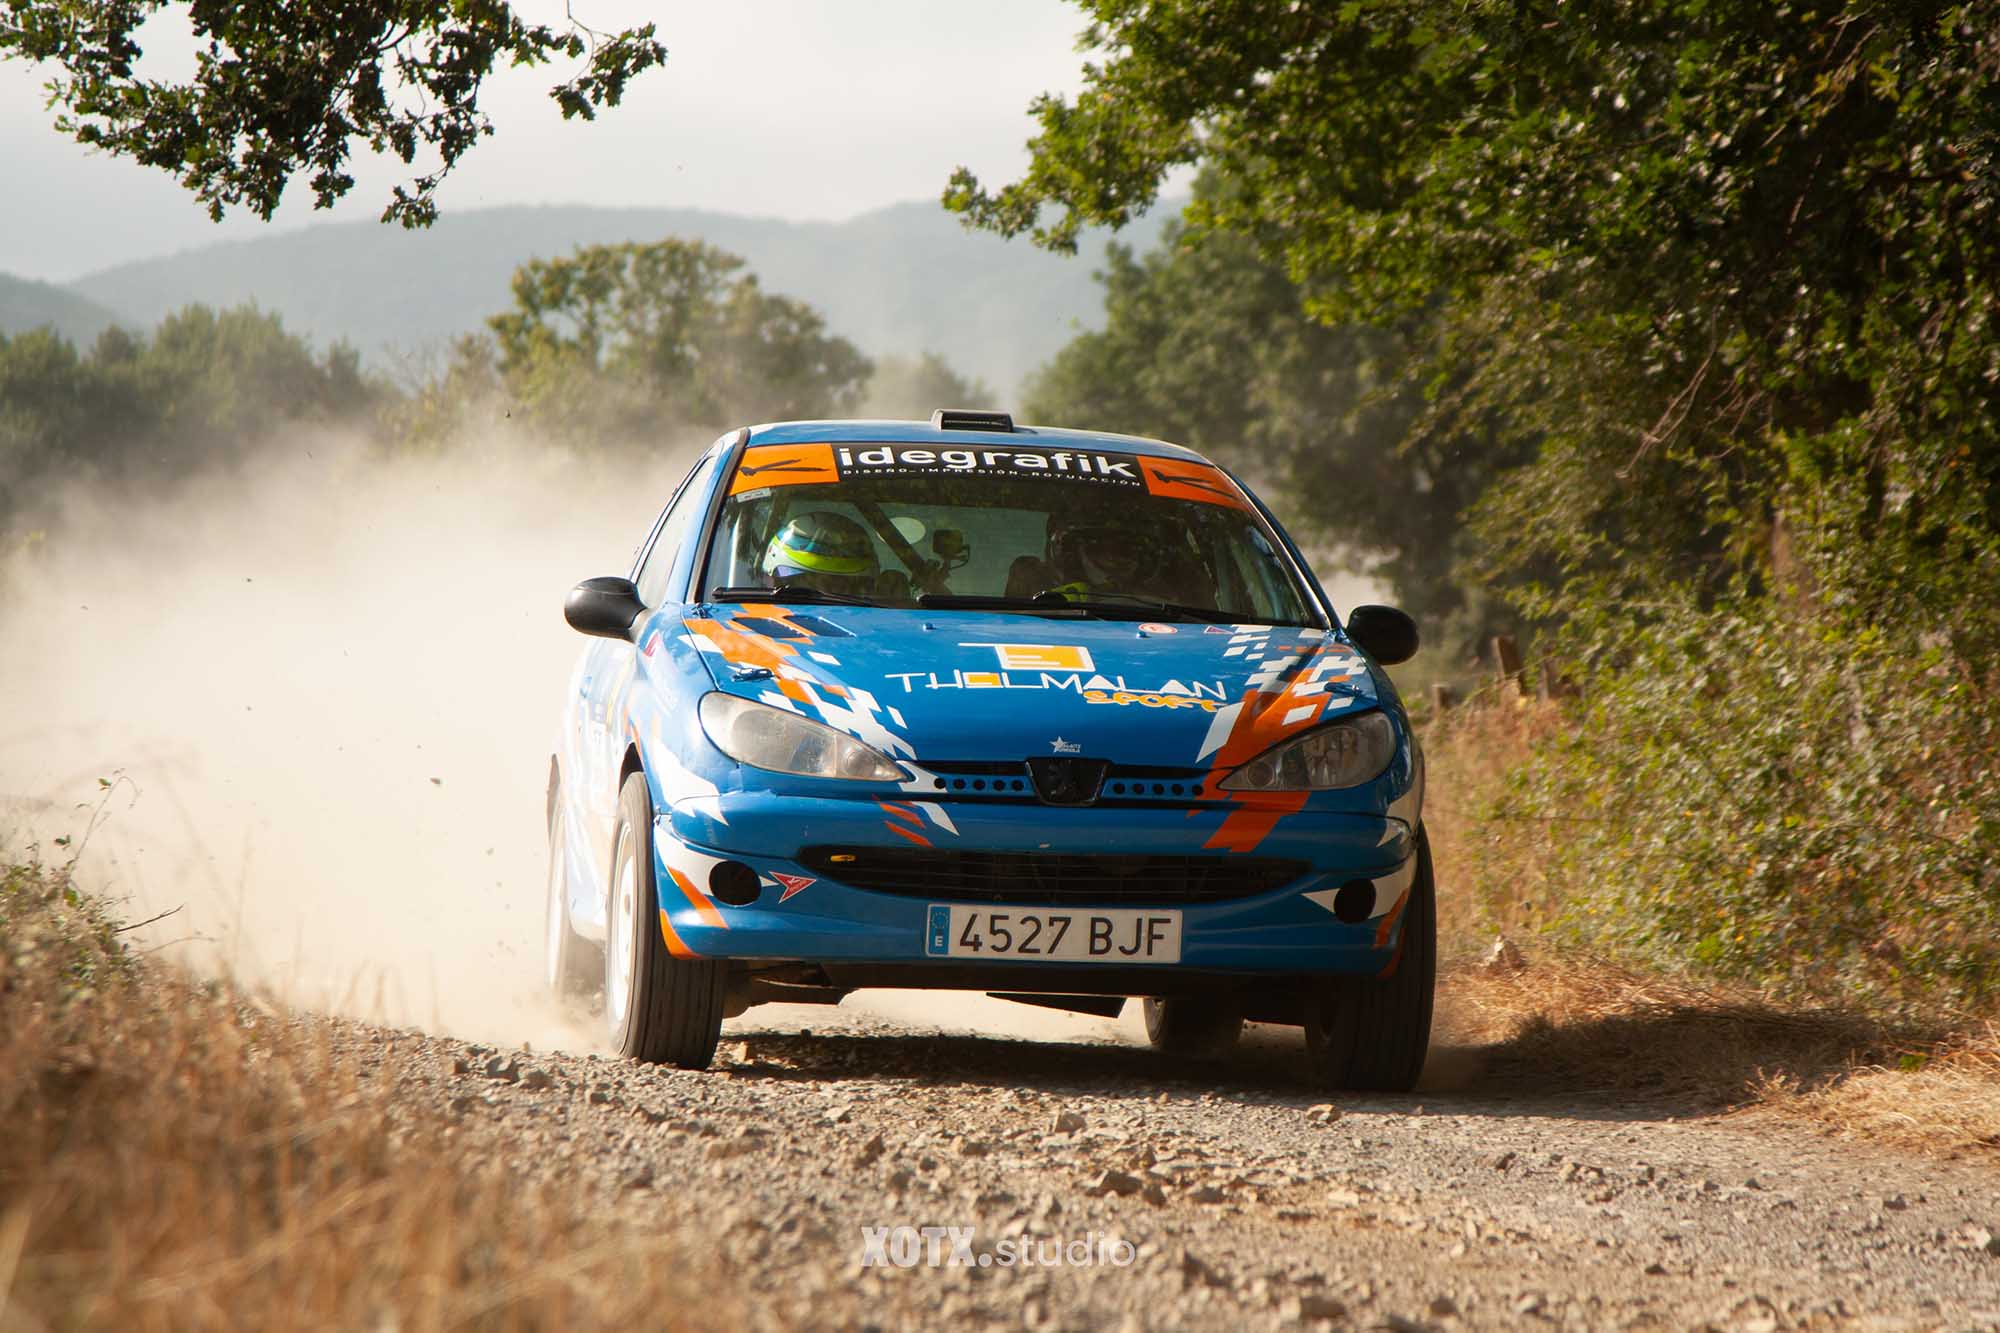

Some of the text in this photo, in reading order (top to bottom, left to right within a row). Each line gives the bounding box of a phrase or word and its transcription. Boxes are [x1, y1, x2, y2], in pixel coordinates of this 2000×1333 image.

[839, 446, 1137, 478] idegrafik
[1083, 690, 1226, 712] SPORT
[935, 935, 943, 947] E
[959, 913, 1172, 956] 4527 BJF
